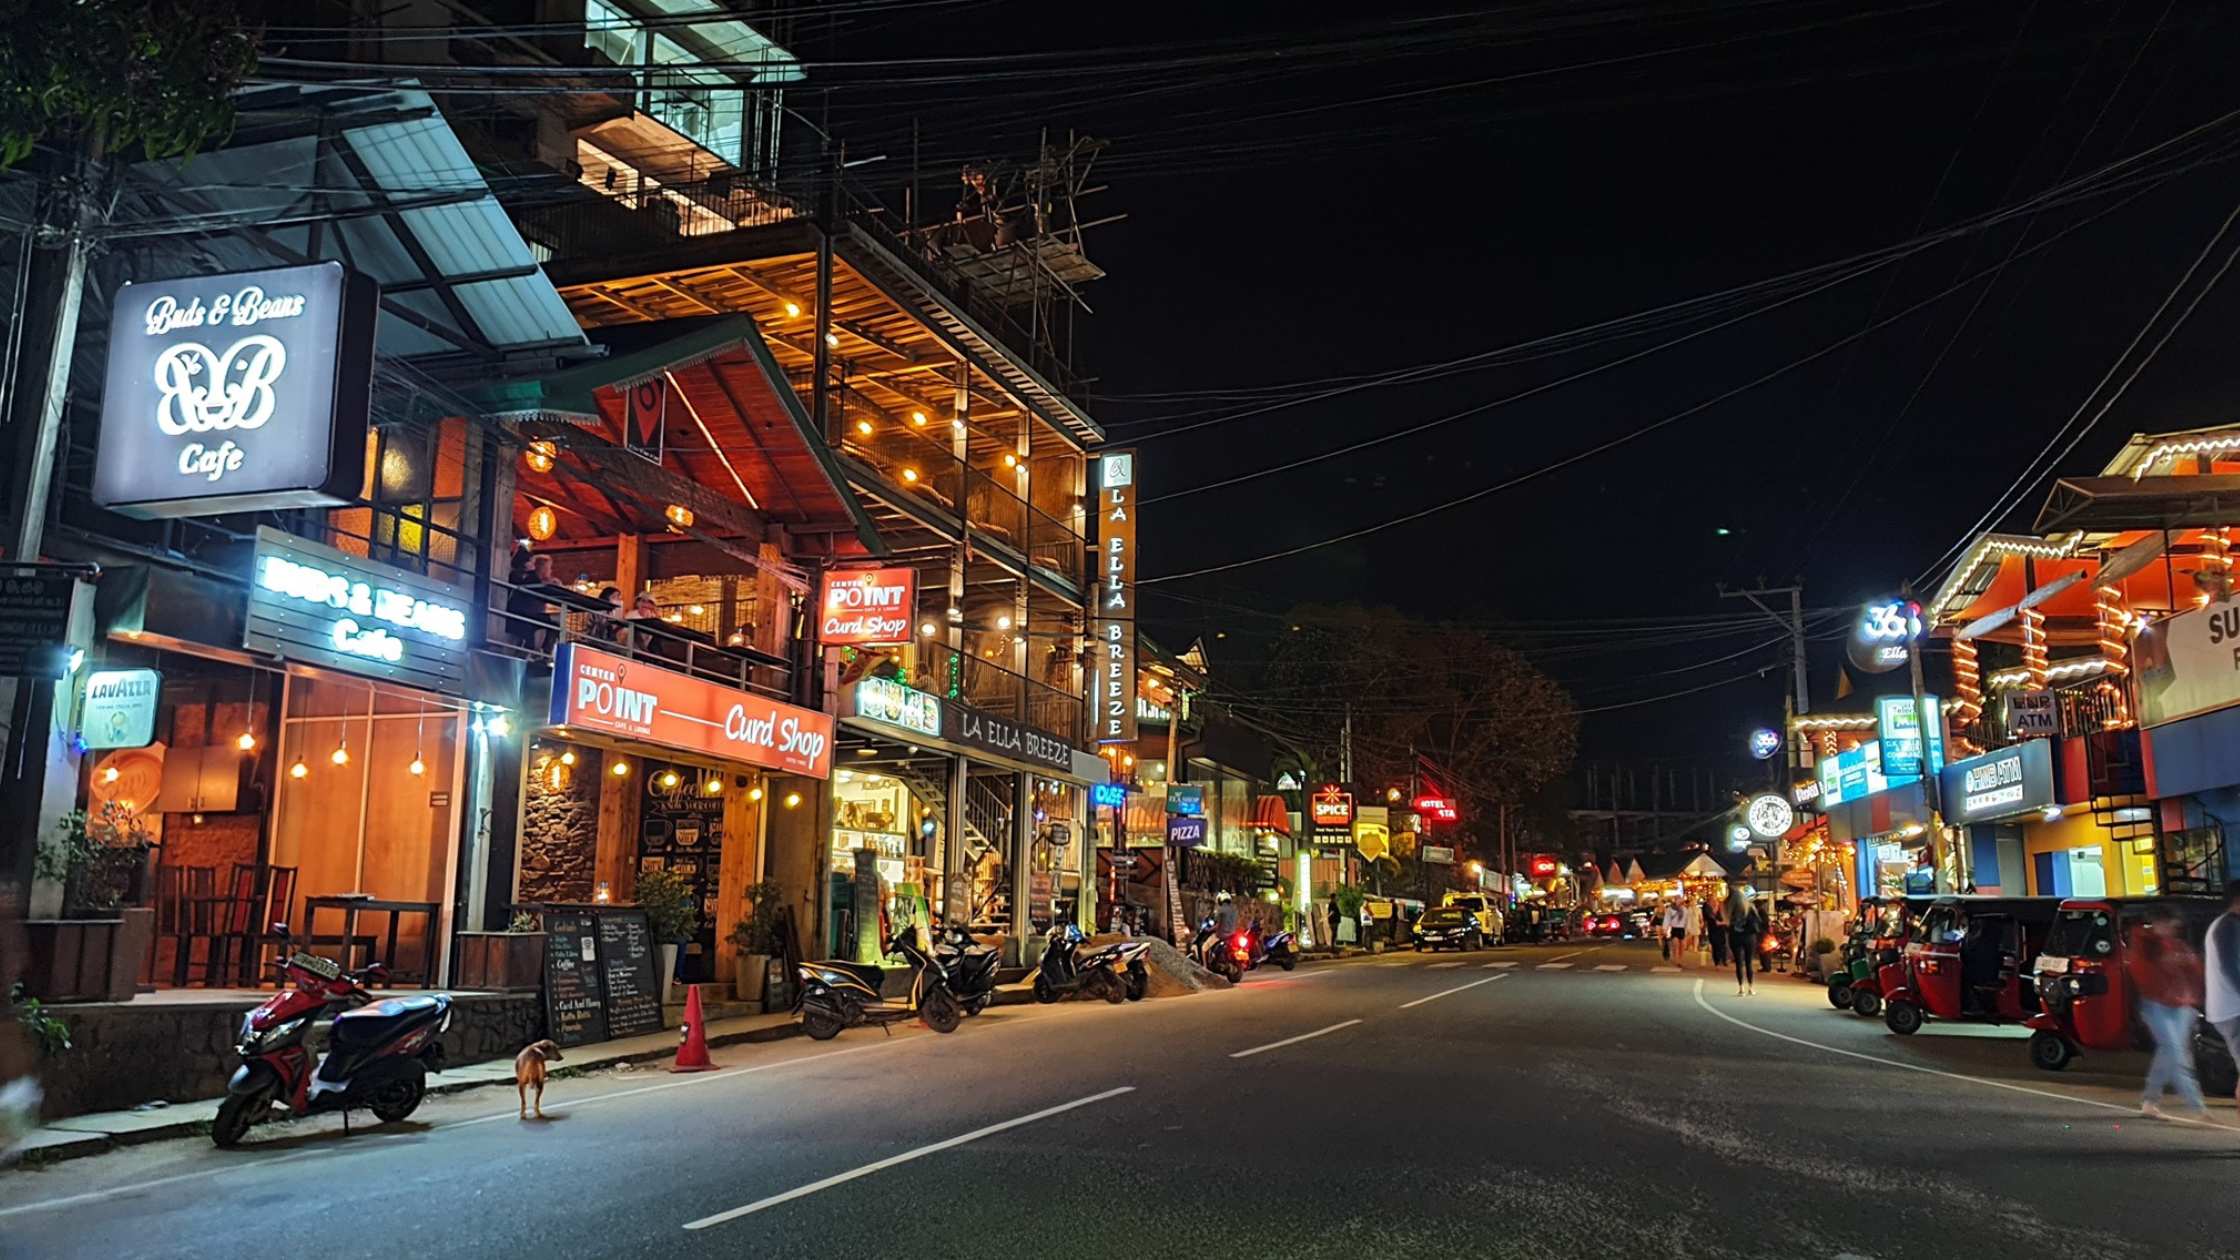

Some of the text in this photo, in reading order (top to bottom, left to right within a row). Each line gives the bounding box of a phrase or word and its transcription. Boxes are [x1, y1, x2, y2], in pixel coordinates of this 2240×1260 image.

[145, 285, 306, 335] Buds & Beans
[178, 440, 244, 481] Cafe
[1110, 537, 1125, 608] ELLA
[829, 586, 905, 608] POINT
[824, 616, 906, 639] Curd Shop
[1880, 646, 1908, 659] Ella
[579, 663, 616, 681] CENTER
[1108, 625, 1125, 735] BREEZE
[90, 677, 151, 699] LAVAZZA
[577, 678, 657, 725] POINT
[2017, 713, 2054, 728] ATM
[725, 704, 825, 770] Curd Shop
[962, 712, 1070, 766] LA ELLA BREEZE
[1316, 803, 1349, 816] SPICE
[1171, 824, 1200, 841] PIZZA
